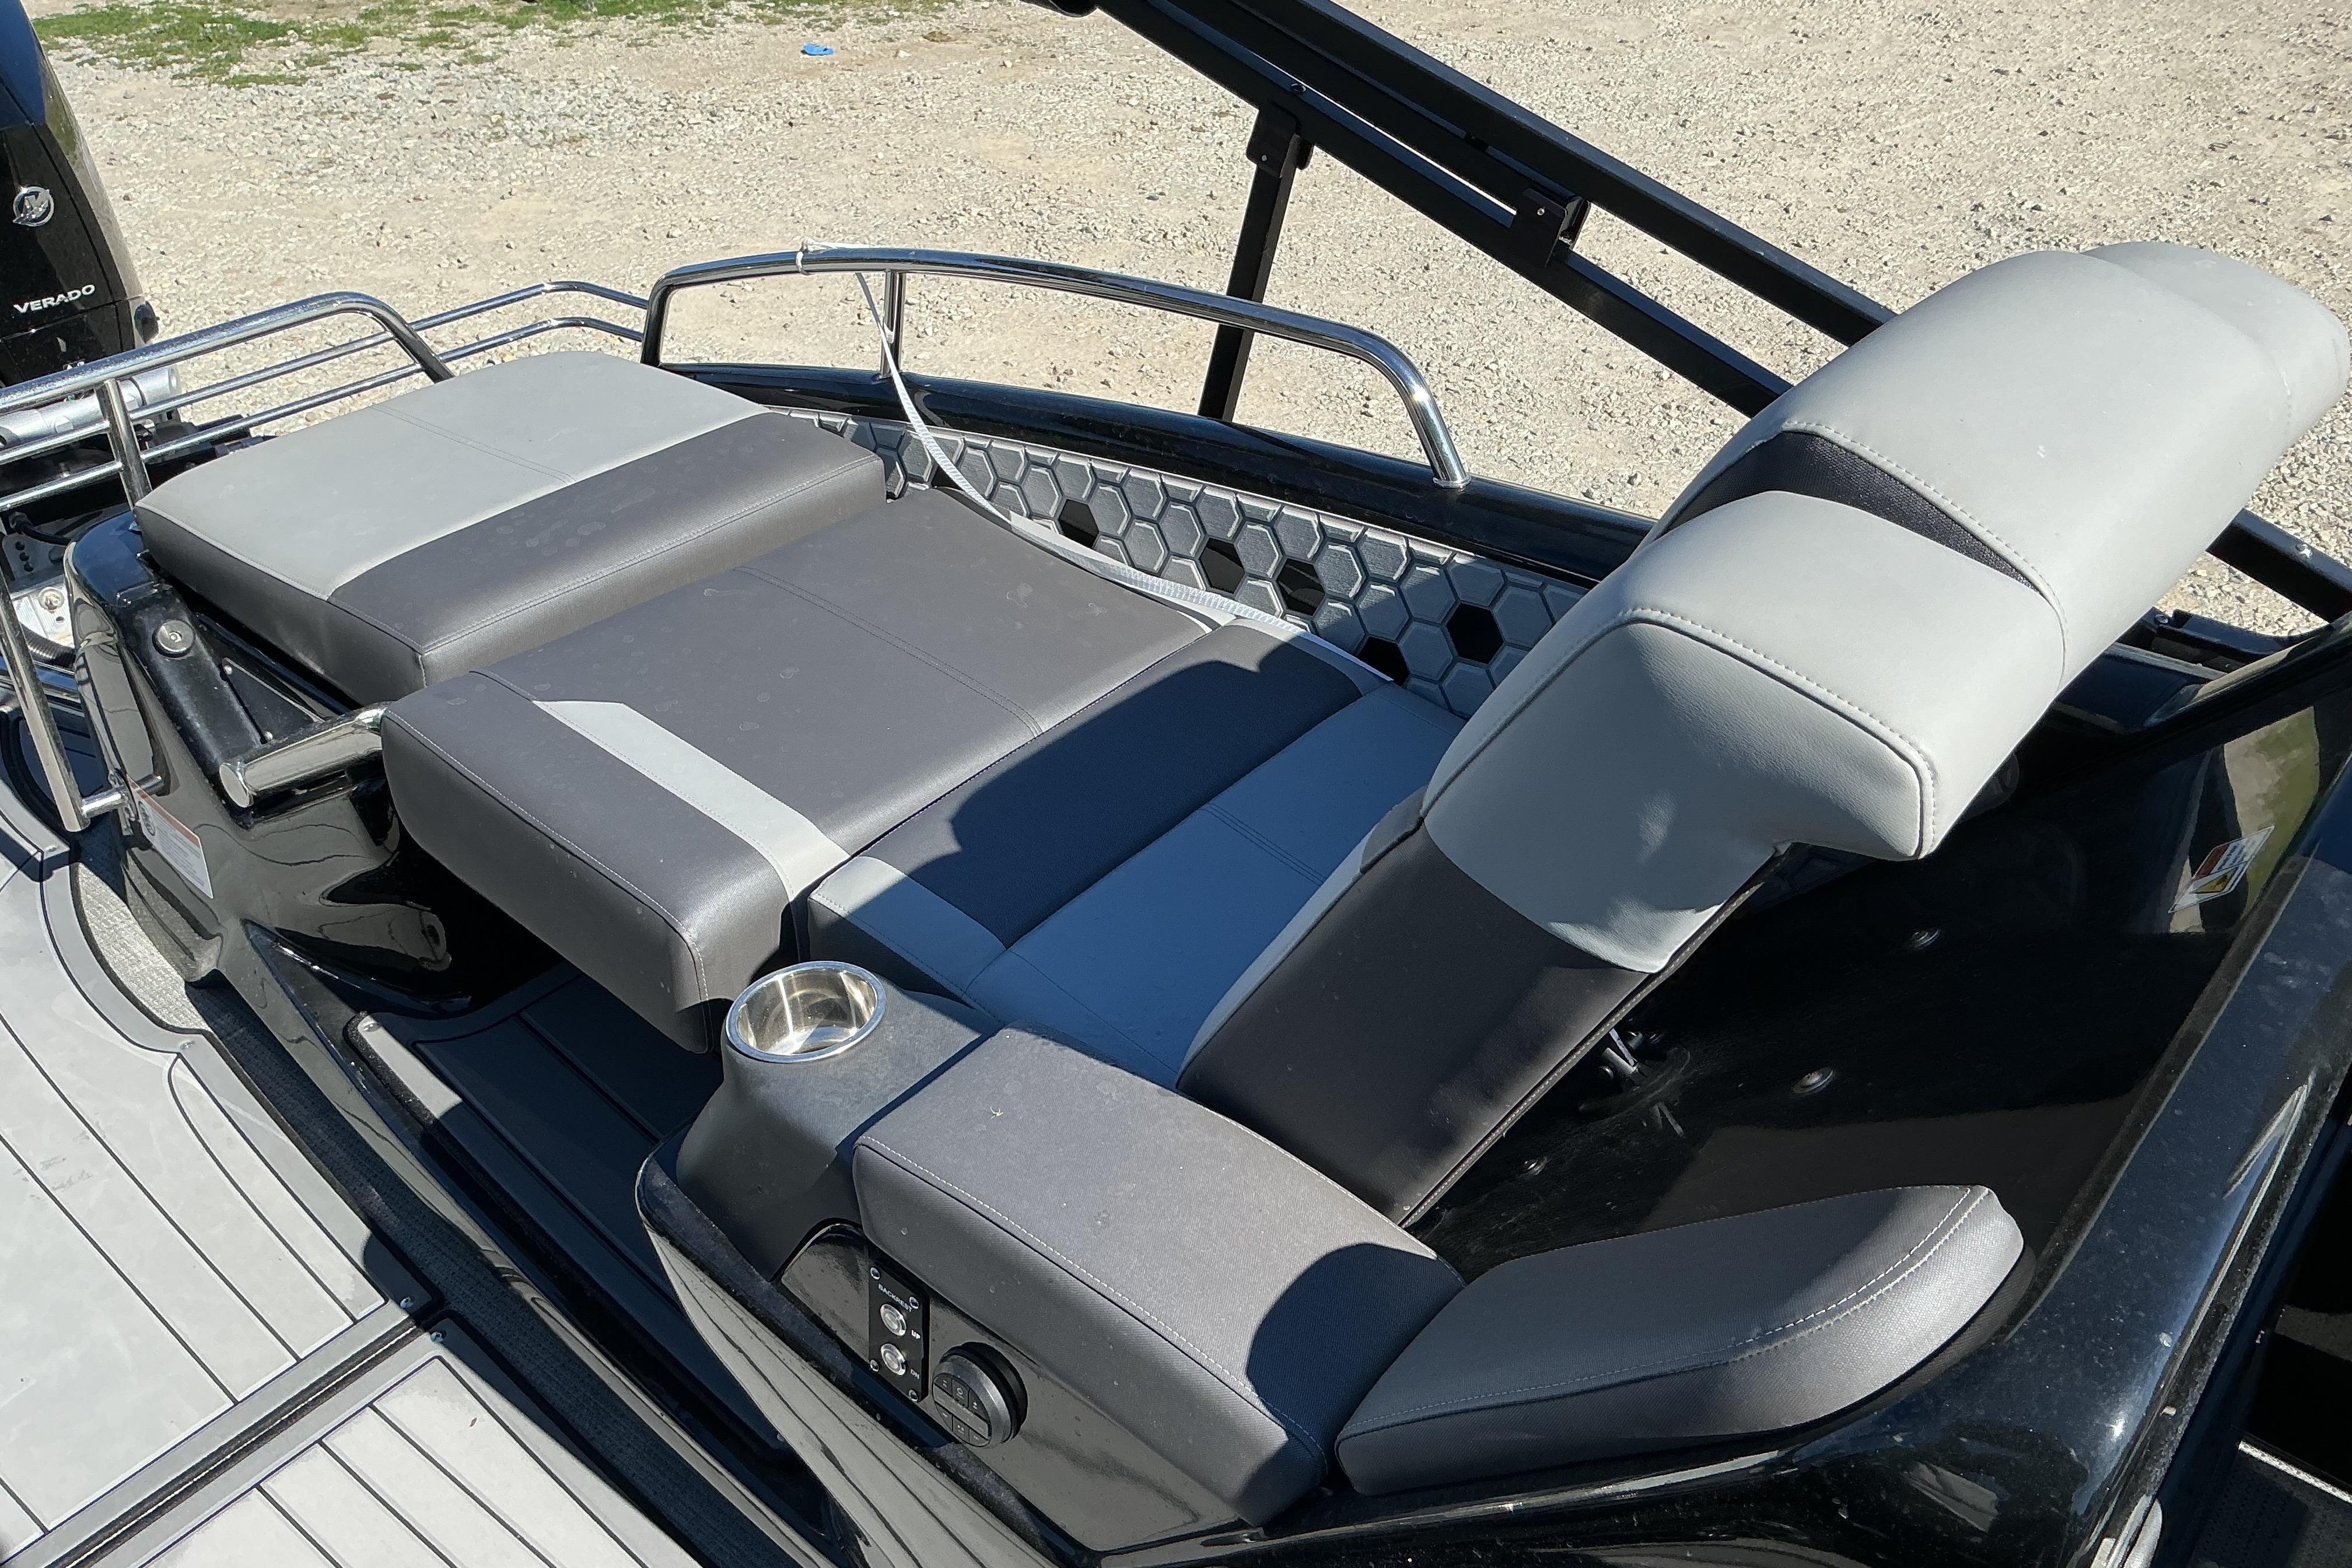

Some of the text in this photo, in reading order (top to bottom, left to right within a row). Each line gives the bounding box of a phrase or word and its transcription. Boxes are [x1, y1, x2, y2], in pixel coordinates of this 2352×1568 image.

[13, 284, 96, 313] VERADO
[878, 1283, 912, 1312] BACKREST
[911, 1329, 921, 1339] UP
